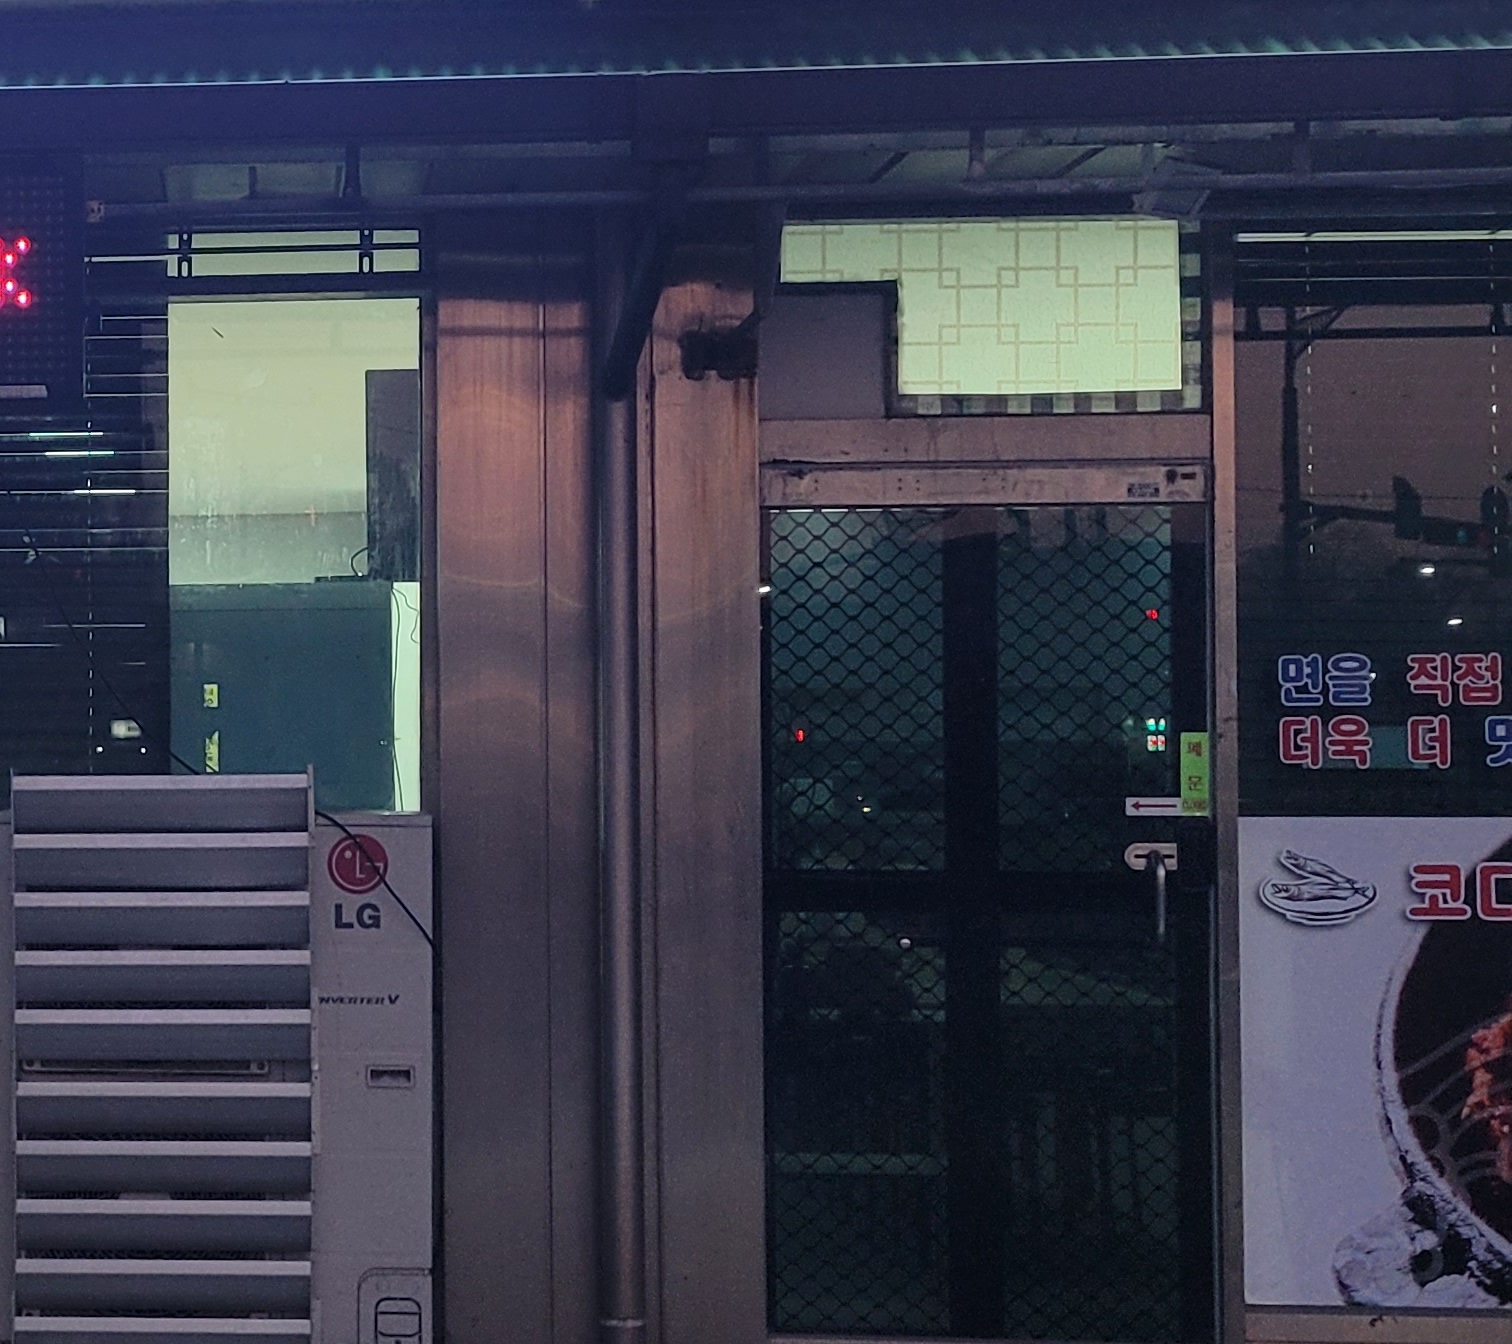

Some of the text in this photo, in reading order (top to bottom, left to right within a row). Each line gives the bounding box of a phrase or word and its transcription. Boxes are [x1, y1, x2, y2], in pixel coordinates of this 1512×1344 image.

[1278, 652, 1502, 706] 면을 직접
[1279, 715, 1372, 769] 더욱
[1407, 714, 1451, 769] 더
[334, 903, 381, 929] LG
